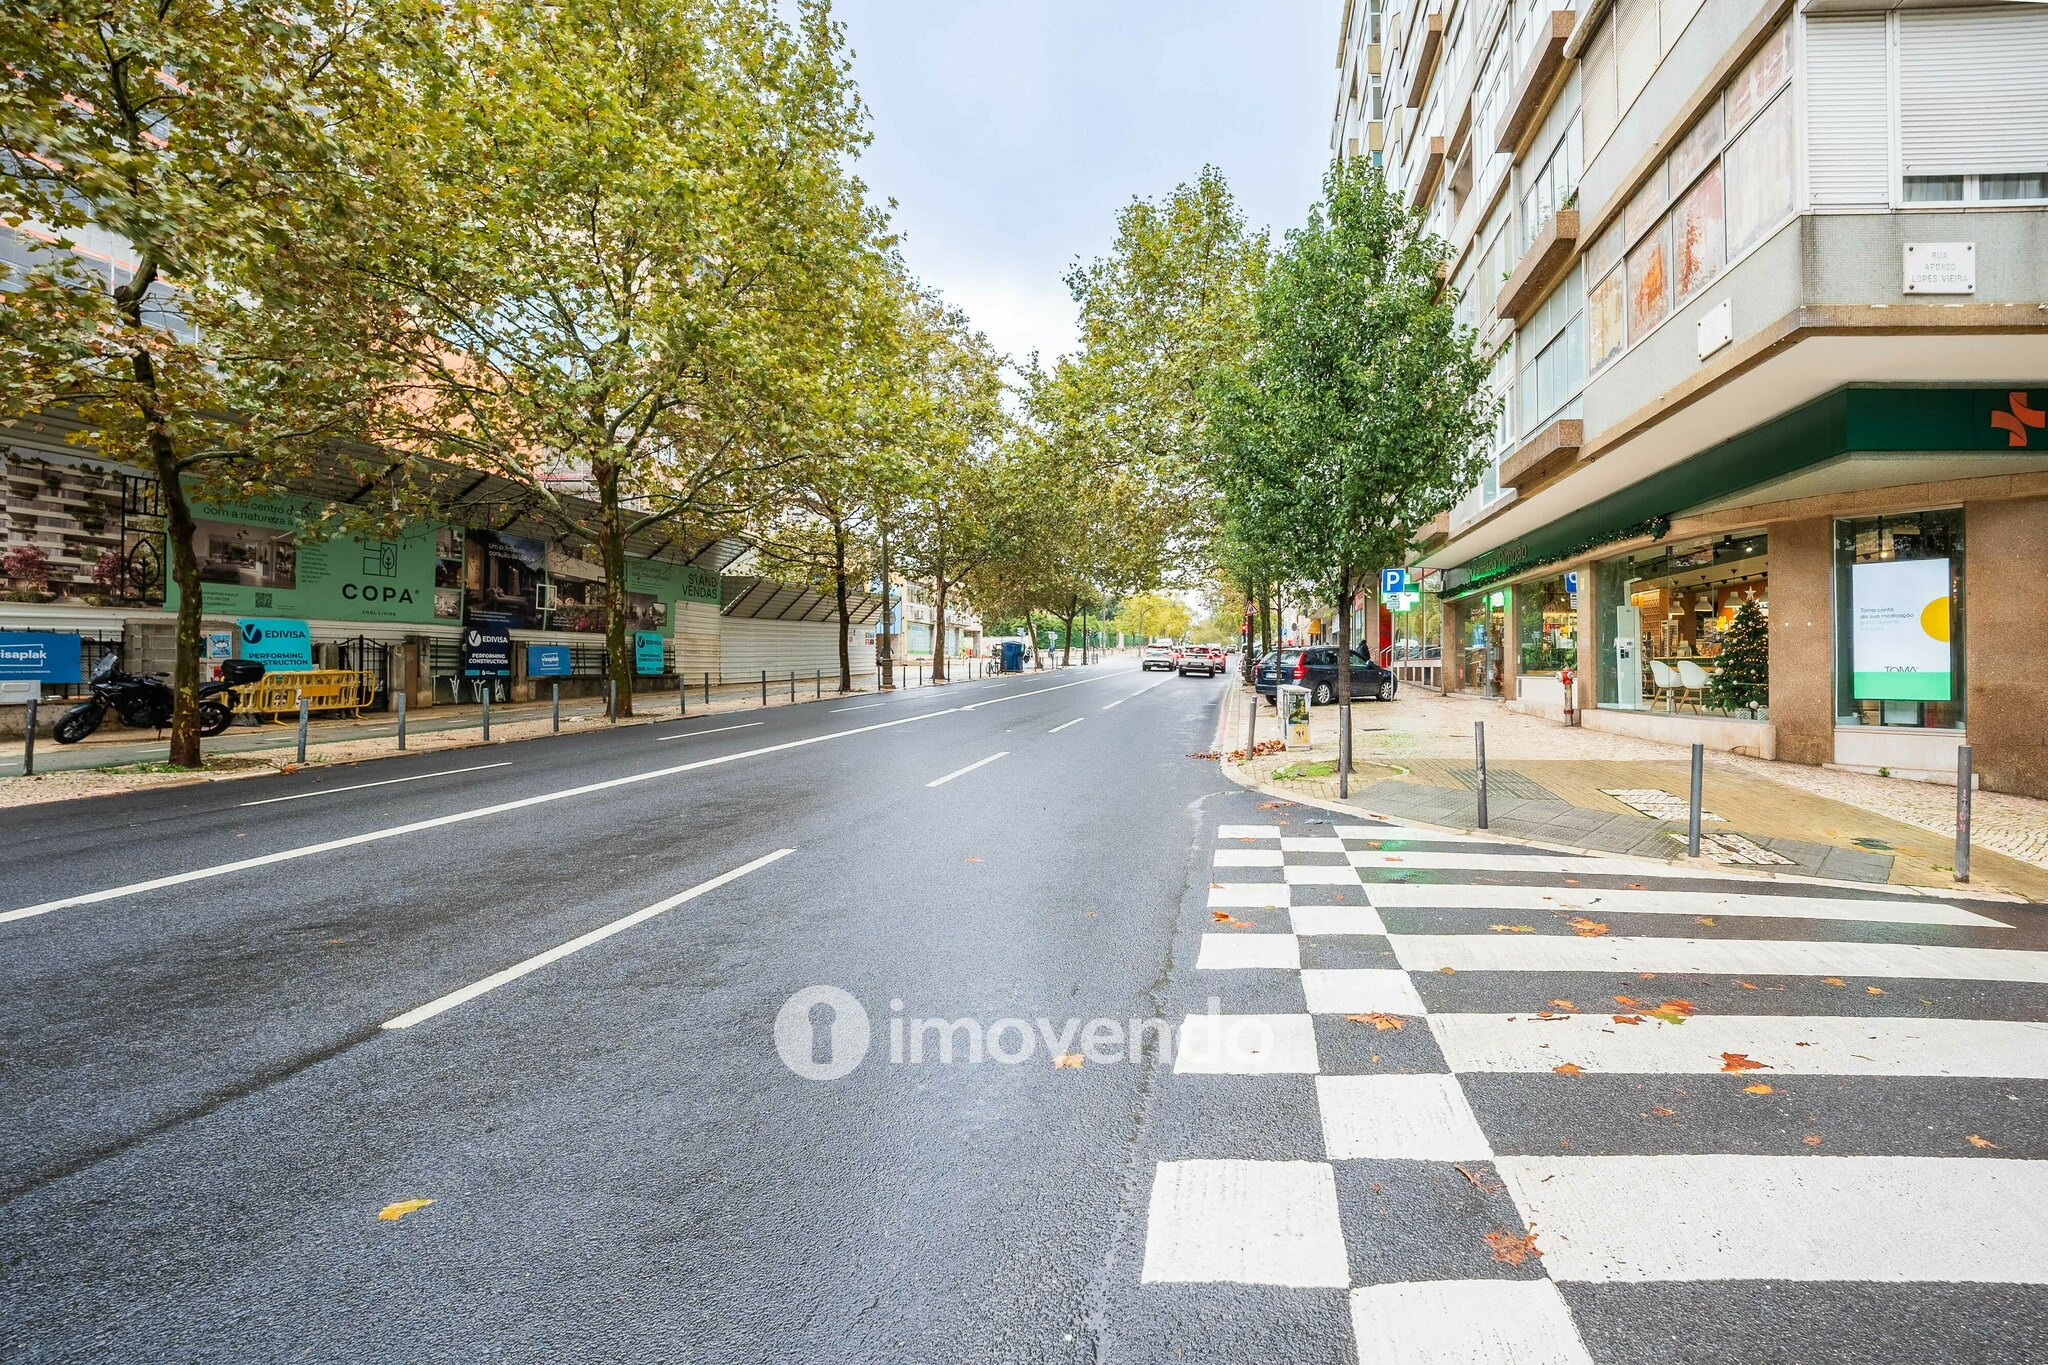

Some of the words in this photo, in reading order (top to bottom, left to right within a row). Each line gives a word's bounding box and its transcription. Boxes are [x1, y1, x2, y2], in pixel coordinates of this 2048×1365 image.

[1932, 251, 1948, 260] RUA
[1925, 263, 1956, 271] AFONSO
[1911, 274, 1938, 282] LOPES
[1941, 274, 1968, 282] VIEIRA
[250, 502, 285, 515] centro
[203, 505, 230, 517] com
[231, 509, 239, 518] a
[240, 511, 286, 525] natureza
[287, 516, 294, 527] à
[688, 573, 718, 588] STAND
[1386, 571, 1400, 591] P
[342, 583, 413, 604] COPA
[681, 584, 718, 599] VENDAS
[265, 630, 306, 639] EDIVISA
[482, 636, 509, 644] EDIVISA
[0, 649, 47, 661] isaplak
